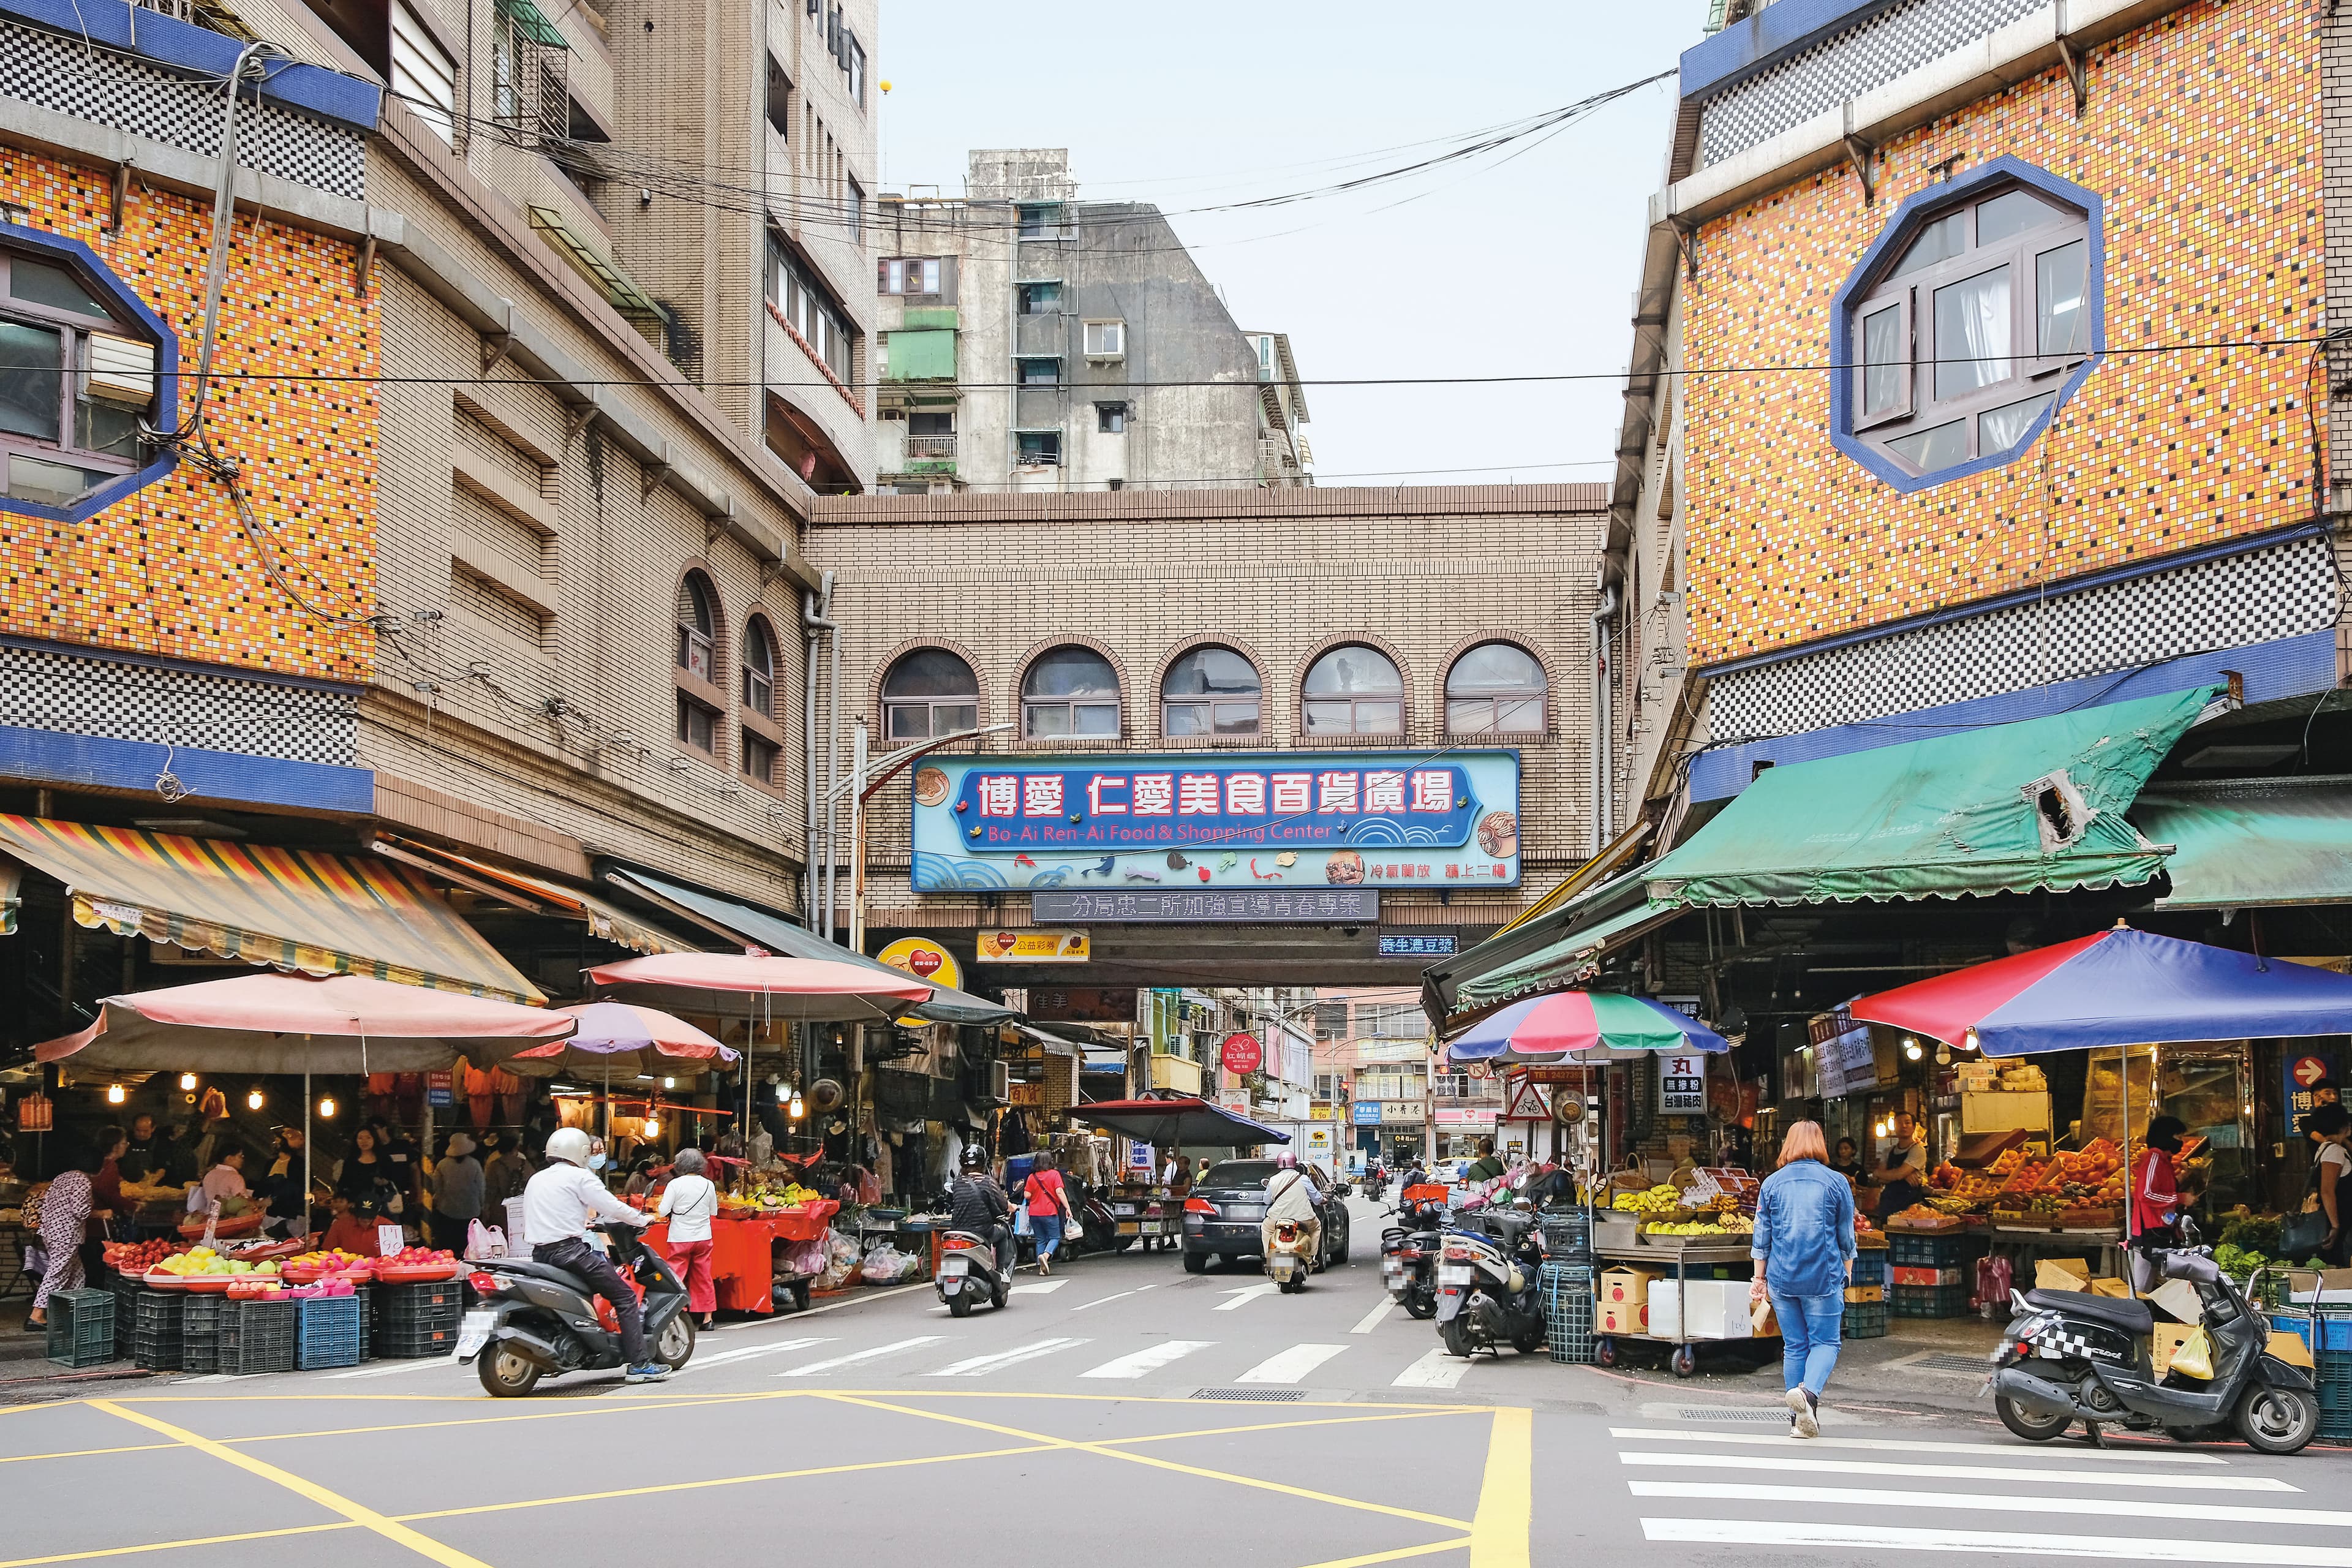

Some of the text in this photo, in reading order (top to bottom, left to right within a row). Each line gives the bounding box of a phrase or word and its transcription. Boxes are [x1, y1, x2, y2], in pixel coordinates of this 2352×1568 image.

[978, 771, 1453, 817] 博愛 仁愛美食百貨廣場
[988, 823, 1333, 843] Bo-Ai Ren-Ai Food & Shopping Center
[1370, 864, 1507, 879] 冷氣開放 請上二樓
[1049, 894, 1361, 918] 一分局忠二所加強宣導青春專案
[1018, 941, 1055, 951] 公益彩券
[1033, 992, 1068, 1009] 佳美
[1672, 1058, 1692, 1074] 丸
[1667, 1079, 1699, 1091] 無摻粉
[1664, 1095, 1702, 1108] 台灣豬肉
[1387, 1104, 1420, 1115] 小香港
